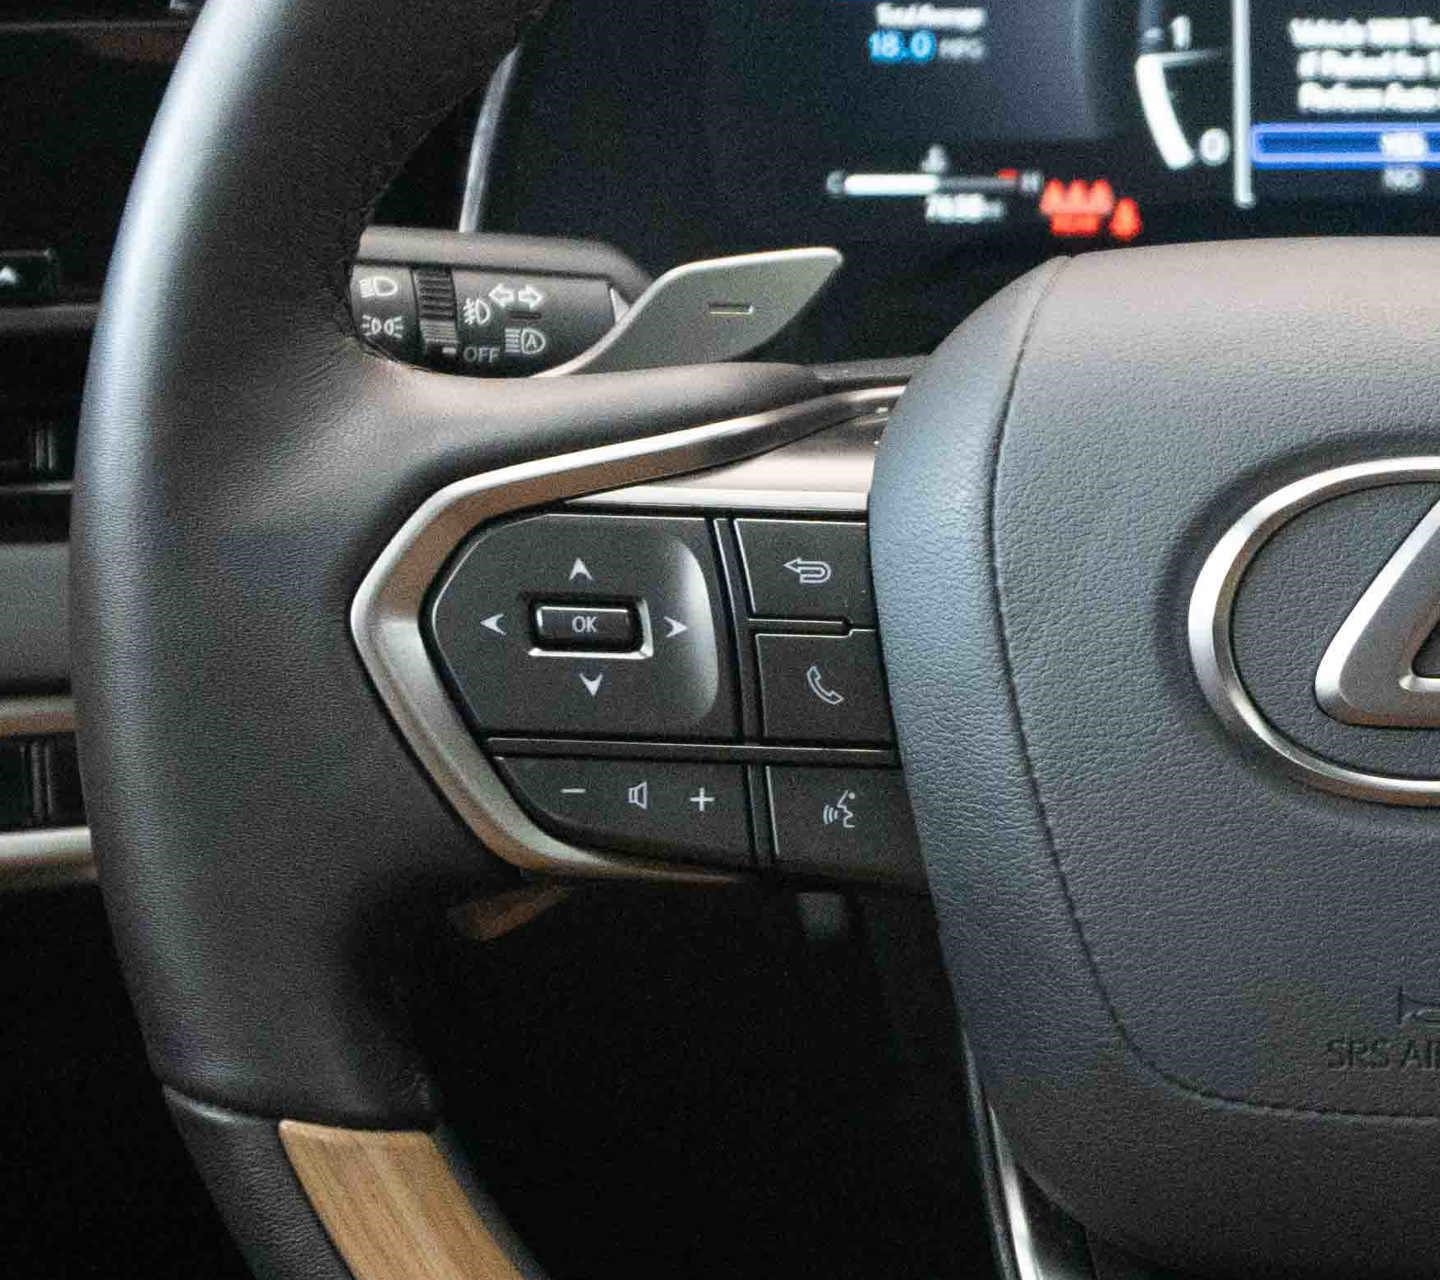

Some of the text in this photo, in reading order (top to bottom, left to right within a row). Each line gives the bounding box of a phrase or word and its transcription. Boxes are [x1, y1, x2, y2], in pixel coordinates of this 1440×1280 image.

[868, 29, 937, 64] 18.0
[1171, 15, 1192, 49] 1
[1199, 127, 1231, 167] 0
[462, 345, 501, 364] OFF
[571, 615, 598, 634] OK
[1327, 1039, 1393, 1072] SRS
